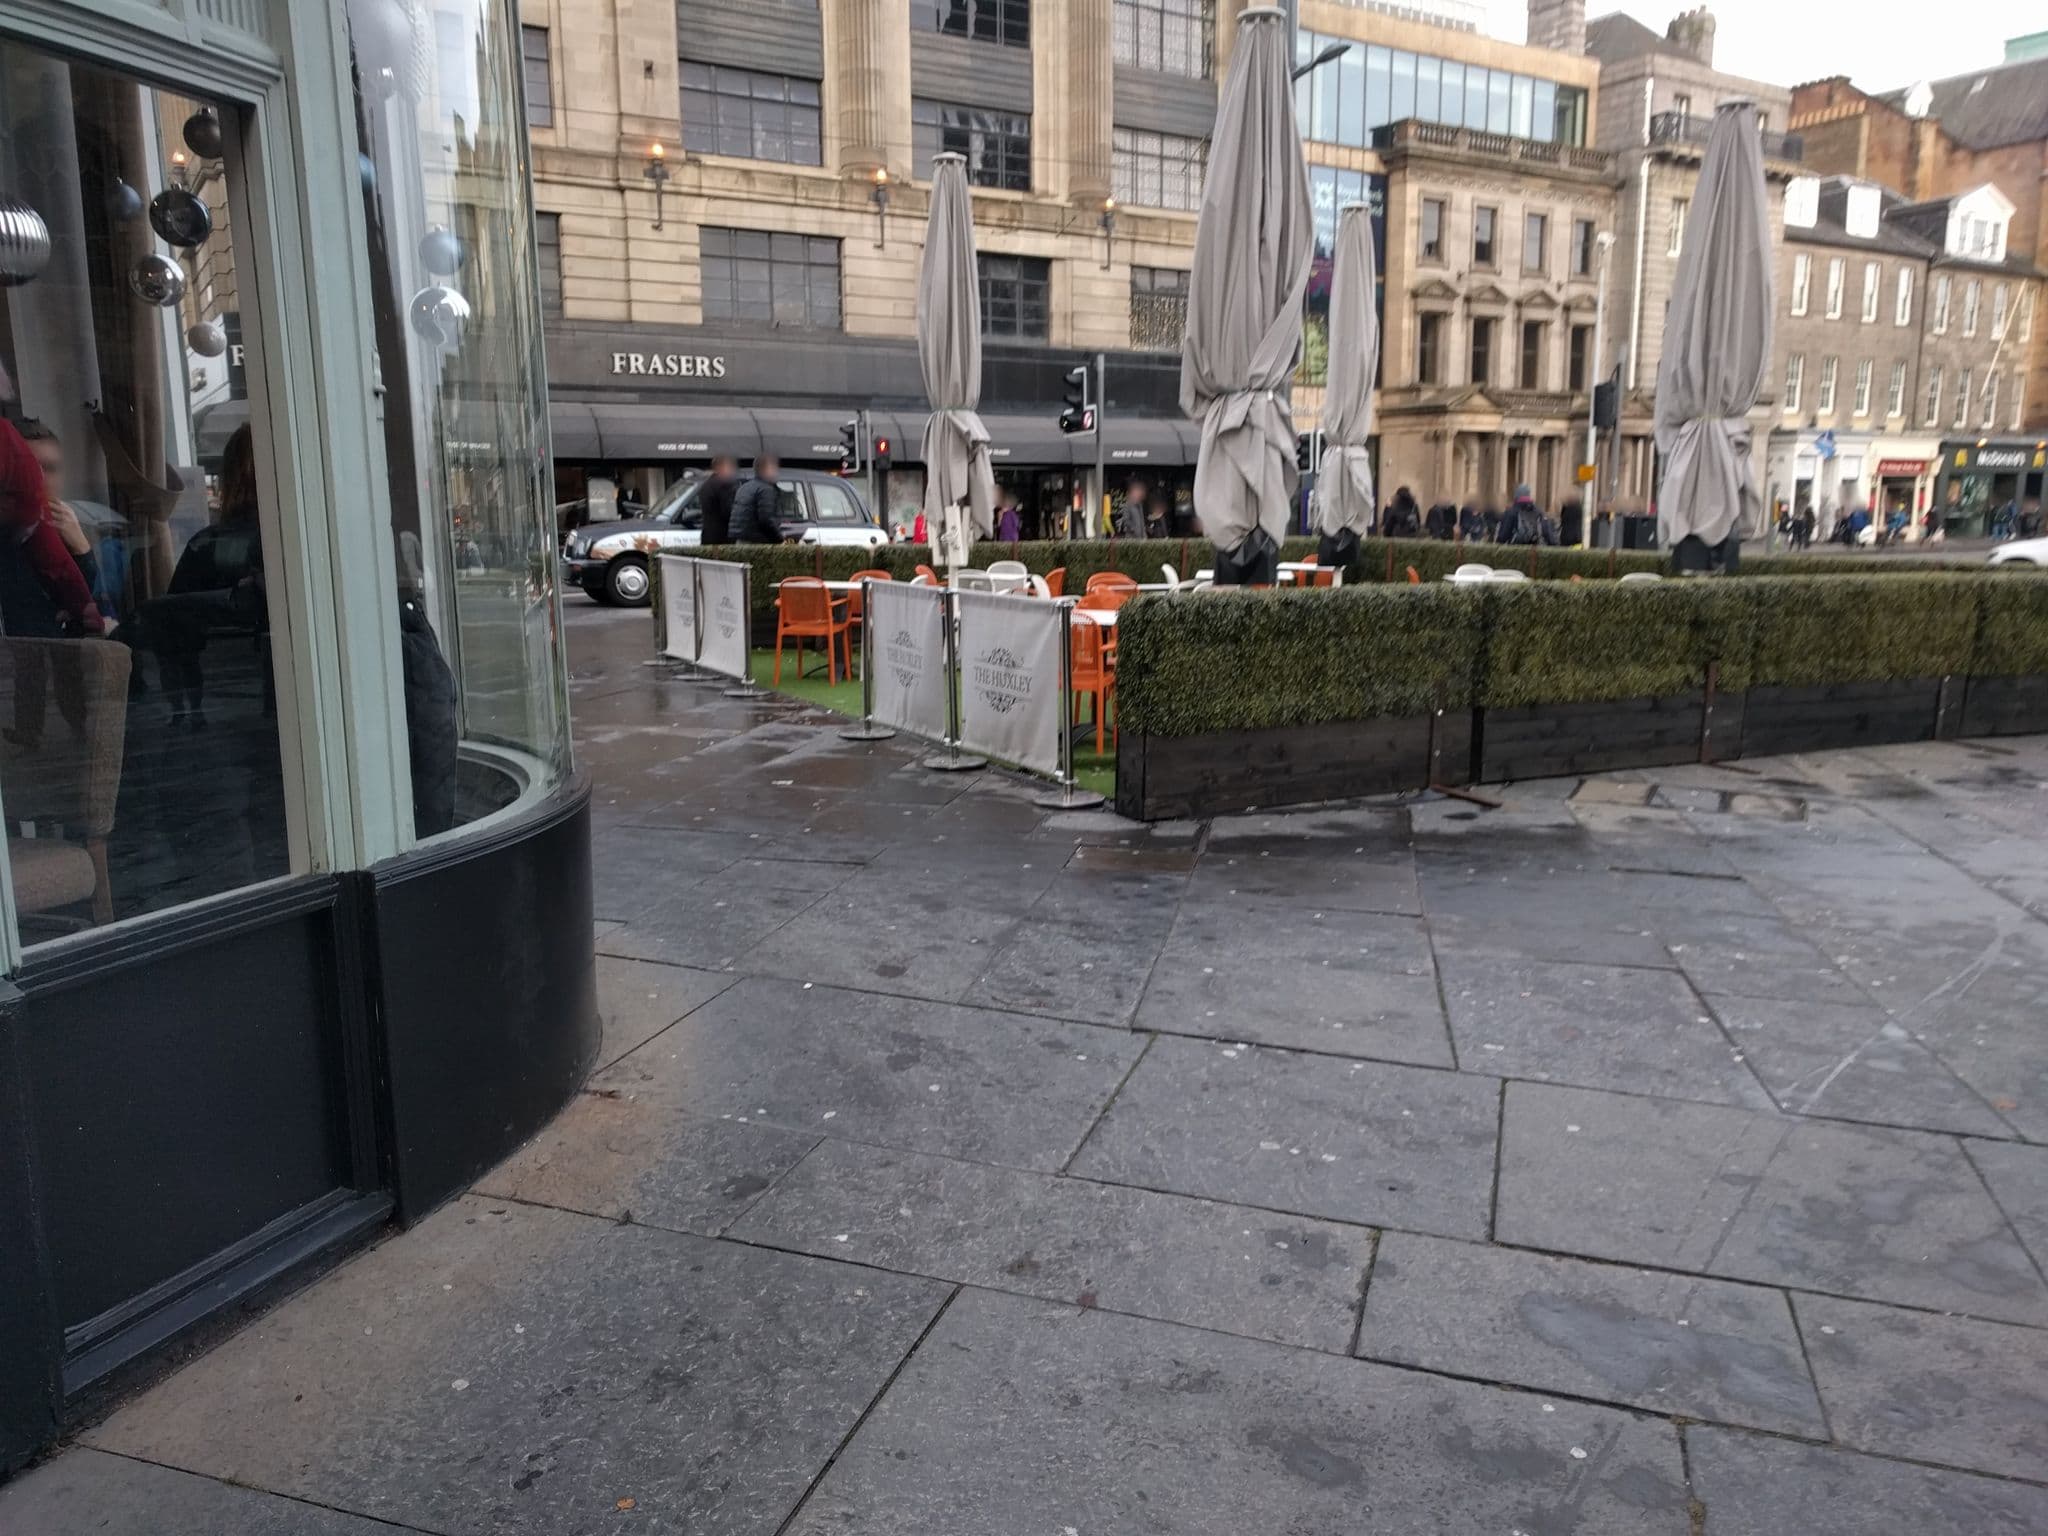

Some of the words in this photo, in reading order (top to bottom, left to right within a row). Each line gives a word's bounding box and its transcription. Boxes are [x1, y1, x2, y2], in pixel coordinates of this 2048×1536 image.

[612, 352, 725, 378] FRASERS
[973, 666, 991, 685] THE
[991, 669, 1033, 694] HUXLEY
